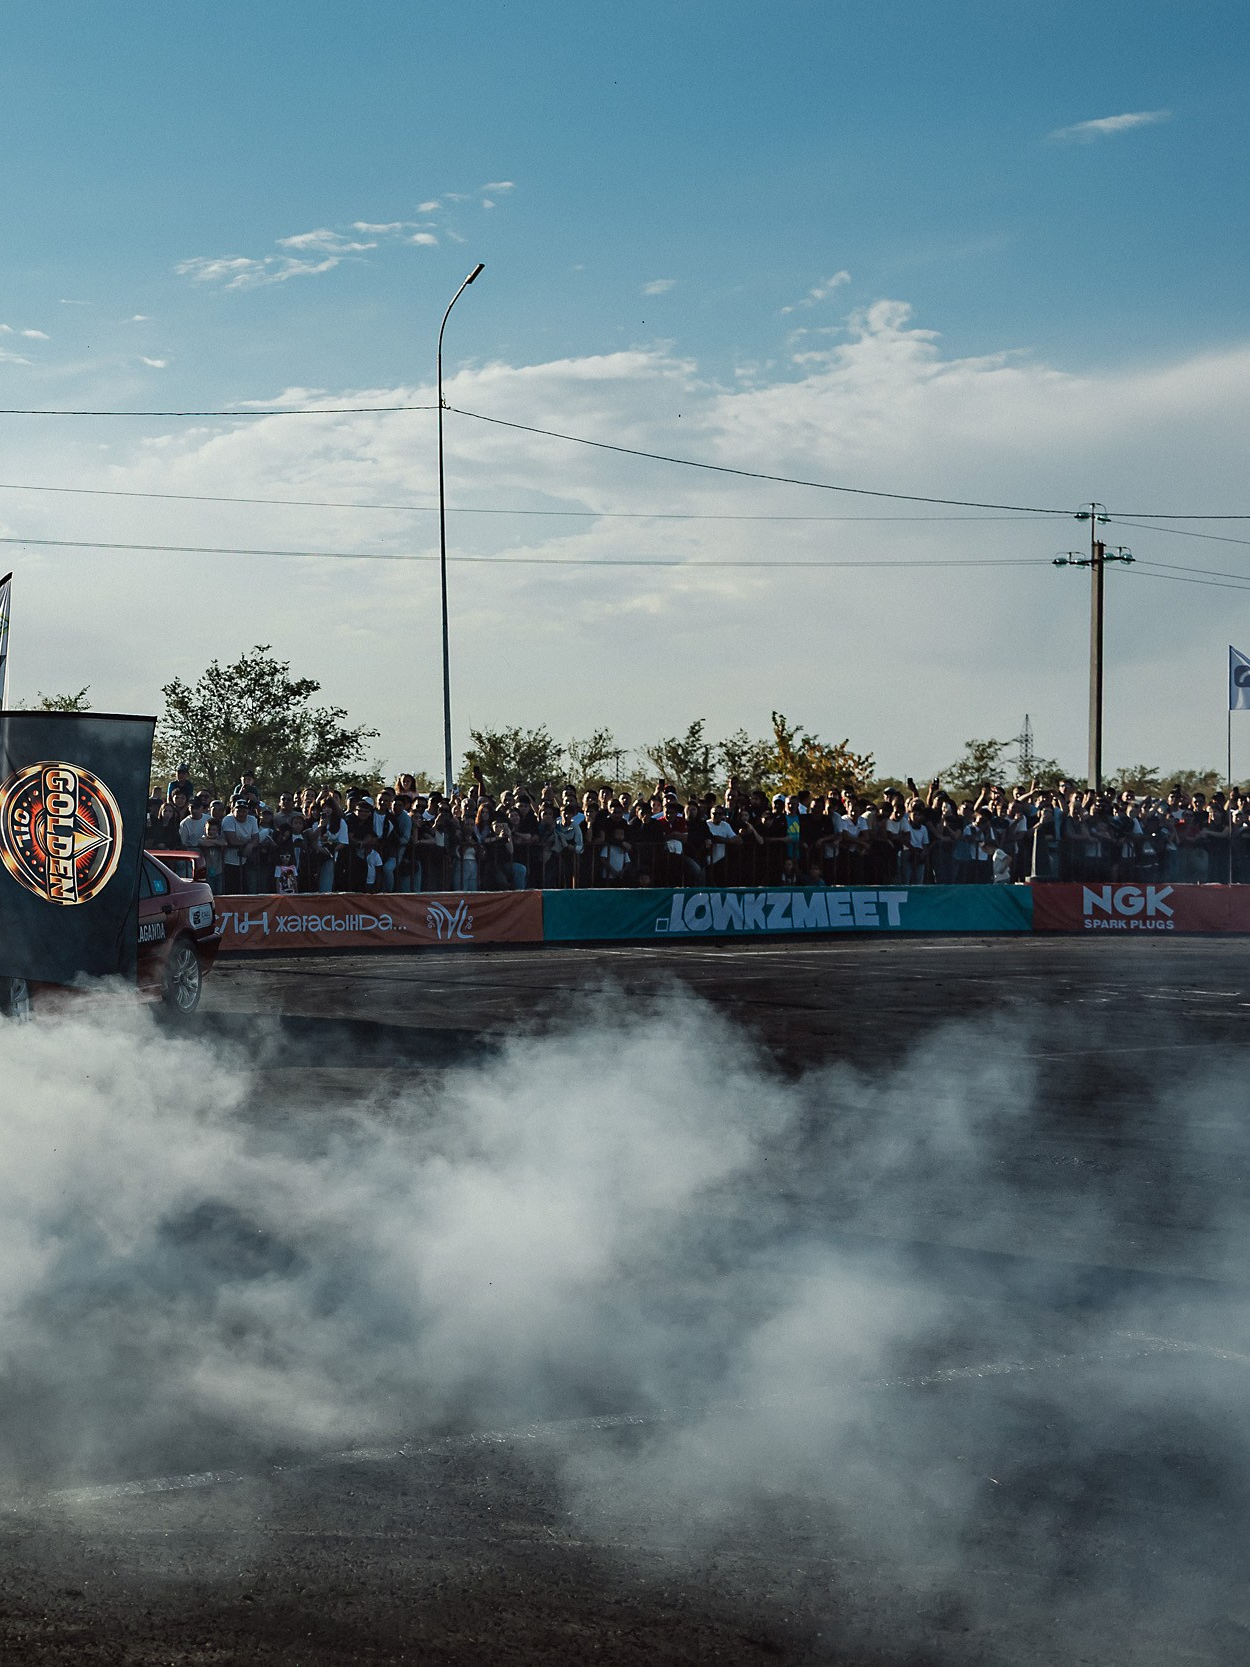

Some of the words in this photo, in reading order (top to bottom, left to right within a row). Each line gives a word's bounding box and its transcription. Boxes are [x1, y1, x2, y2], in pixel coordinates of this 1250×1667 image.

[13, 808, 31, 848] OIL
[46, 769, 76, 901] GOLDEN
[1082, 885, 1174, 917] NGK
[137, 921, 166, 943] AGANDA
[1084, 919, 1127, 929] SPARK
[1130, 919, 1174, 930] PLUGS
